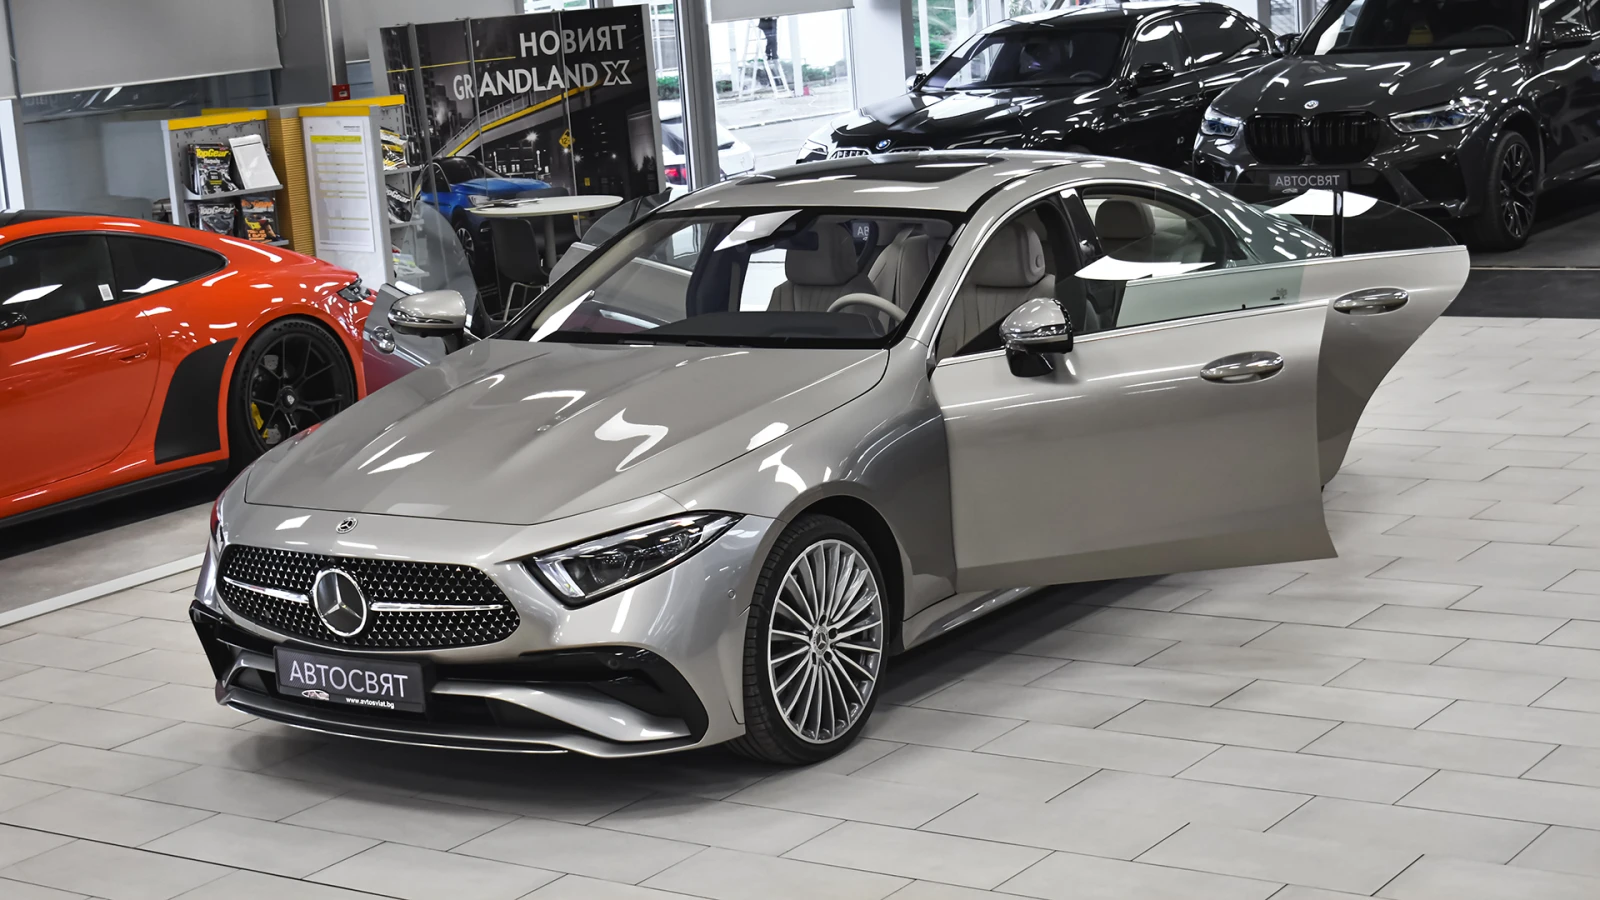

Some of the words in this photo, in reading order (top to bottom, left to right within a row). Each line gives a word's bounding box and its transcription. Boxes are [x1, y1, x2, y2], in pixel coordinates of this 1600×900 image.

[519, 24, 627, 58] НОВИЯТ
[453, 62, 599, 101] GRANDLAND
[600, 59, 633, 87] X
[1274, 174, 1341, 187] АВТОСВЯТ
[289, 660, 409, 698] АВТОСВЯТ
[345, 697, 395, 709] www.avtosviat.bg
